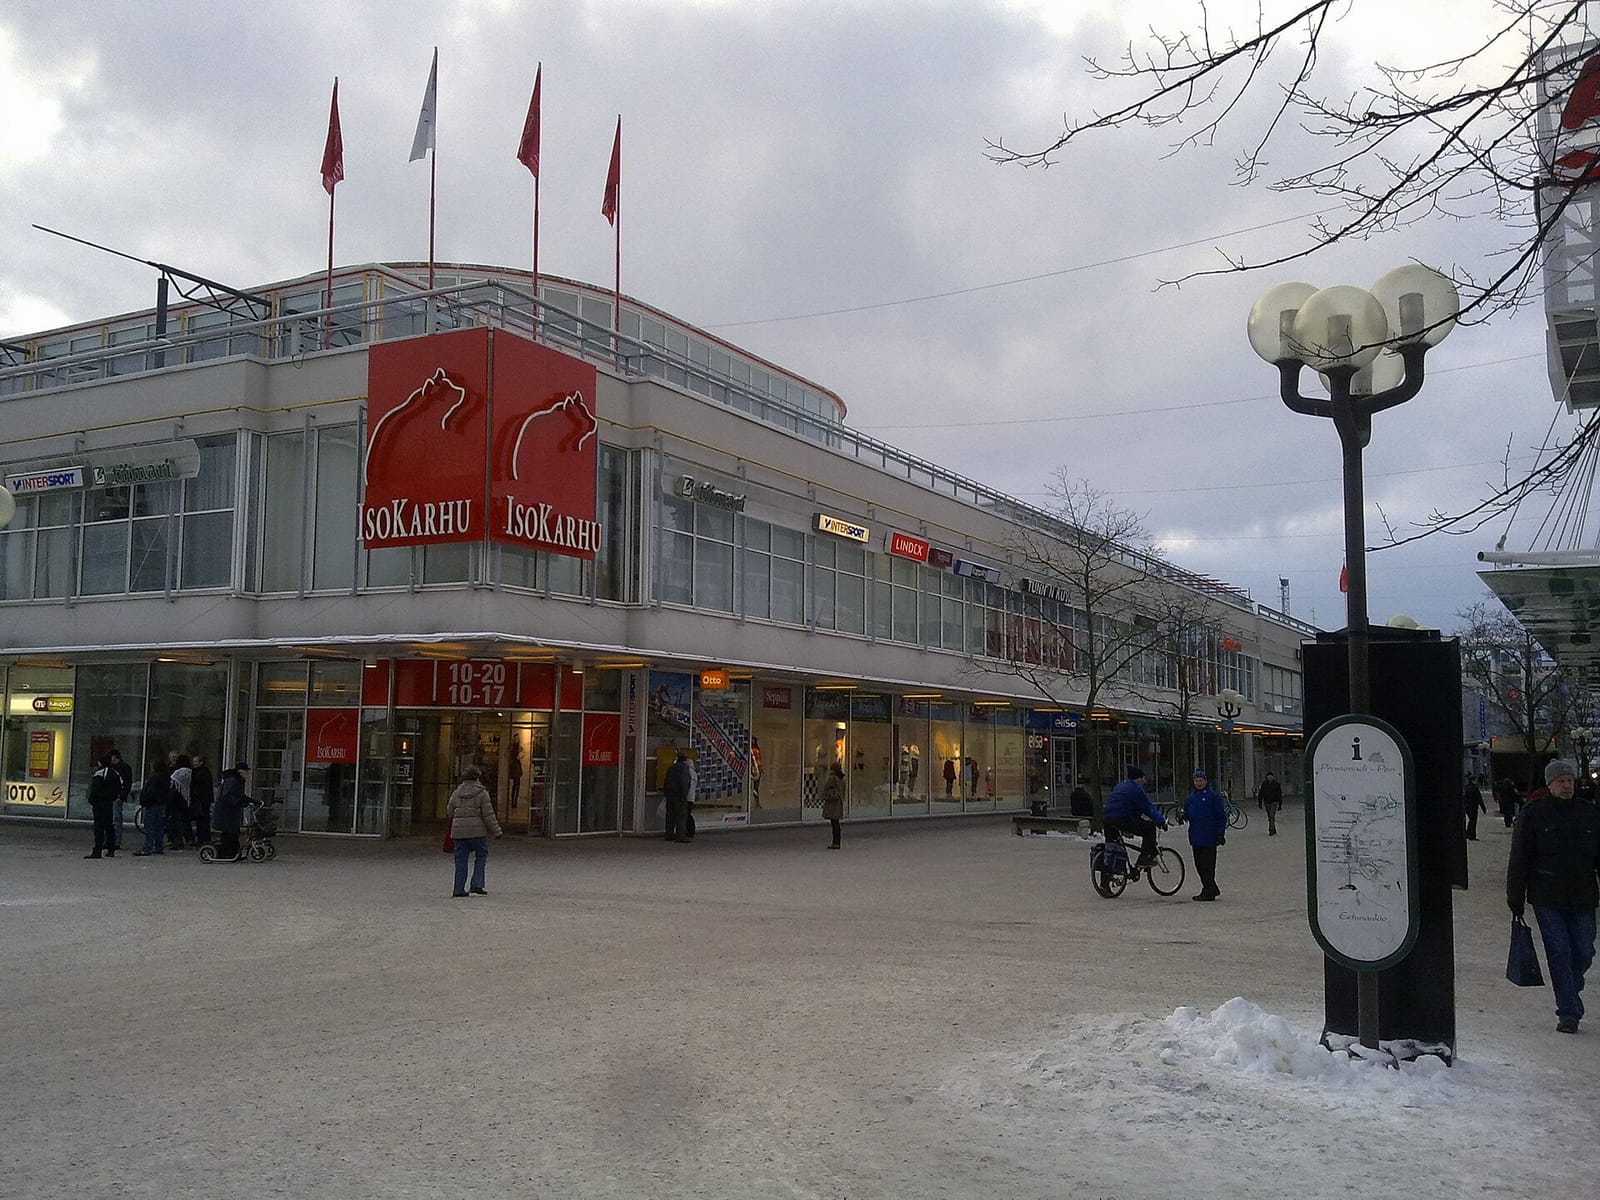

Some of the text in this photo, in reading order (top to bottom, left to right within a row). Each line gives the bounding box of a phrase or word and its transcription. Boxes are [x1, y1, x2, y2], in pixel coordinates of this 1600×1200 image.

[22, 471, 75, 491] INTERSPORT
[357, 498, 471, 541] ISOKARHU
[505, 495, 602, 552] ISOKARHU
[830, 519, 865, 539] INTERSPORT
[895, 538, 923, 557] LINDEX
[449, 663, 506, 684] 10-20
[448, 684, 505, 705] 10-17
